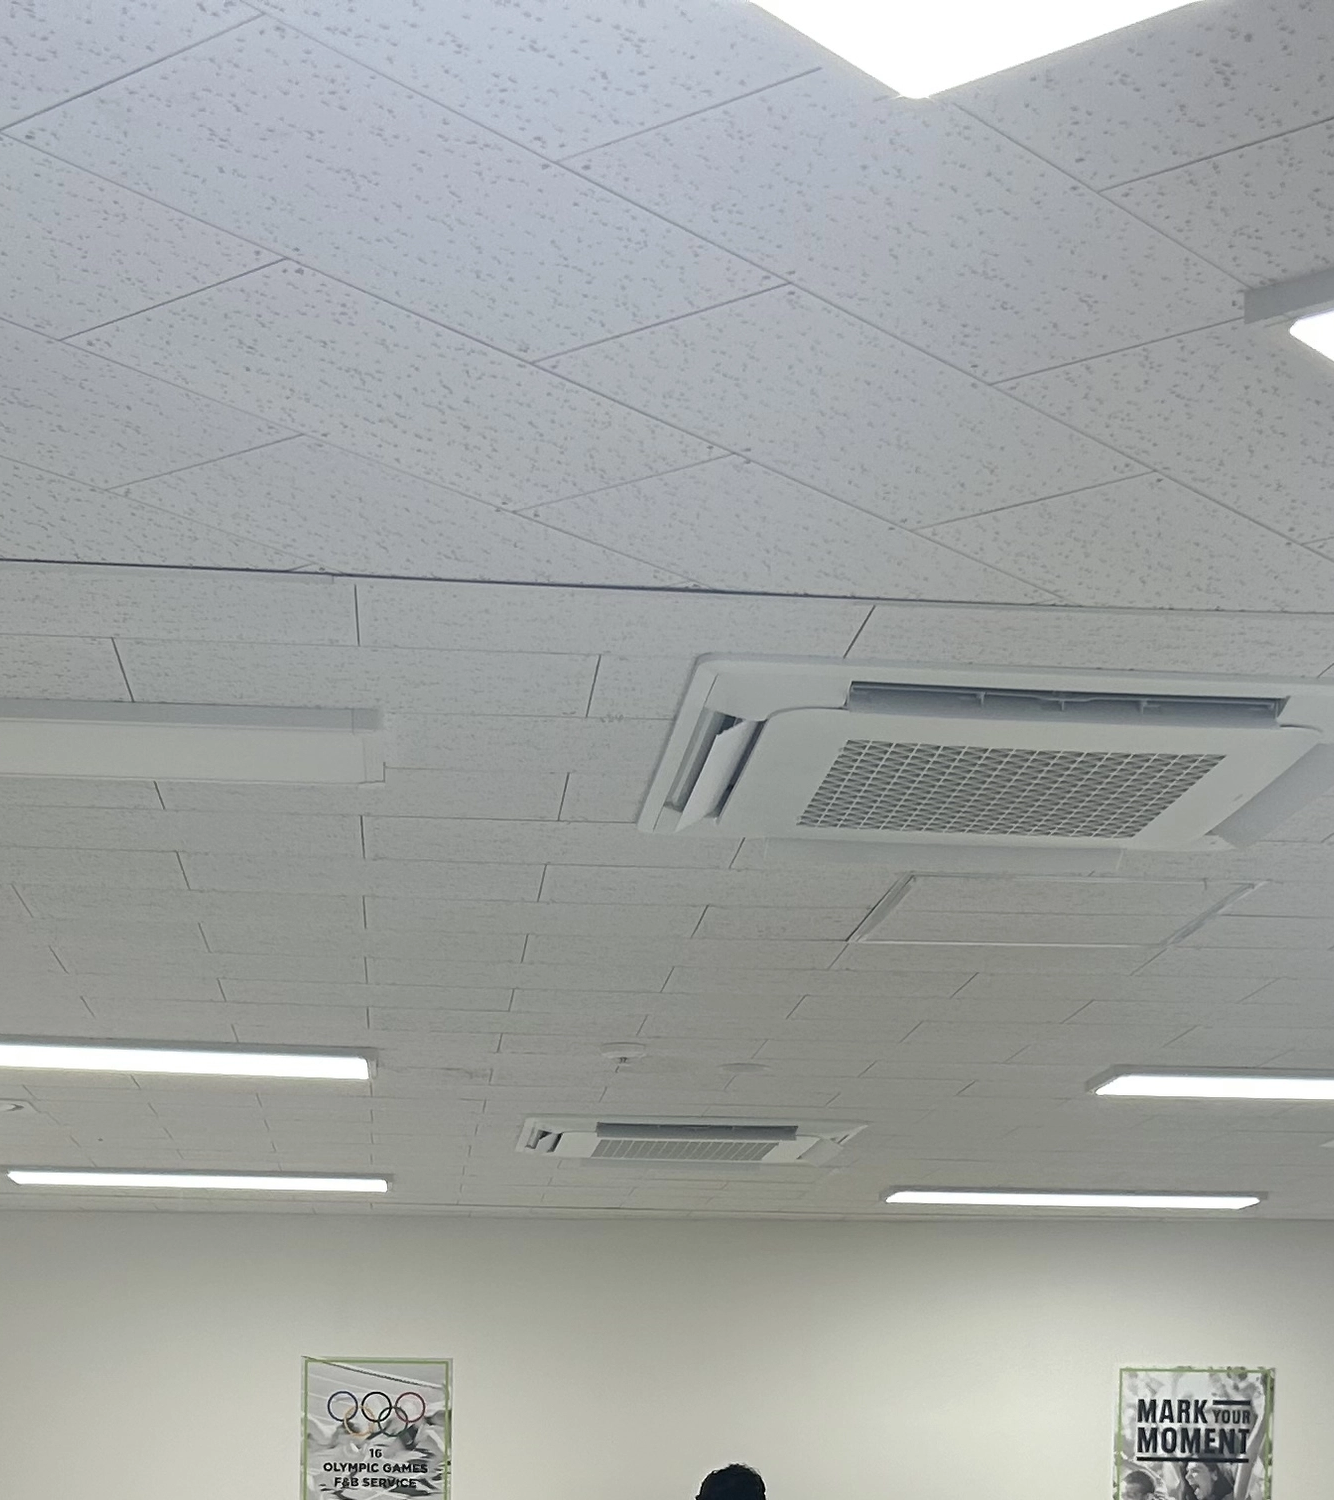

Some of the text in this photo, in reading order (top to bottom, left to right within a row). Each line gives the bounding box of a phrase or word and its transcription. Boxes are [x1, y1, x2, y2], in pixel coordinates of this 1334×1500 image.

[1137, 1398, 1251, 1424] MARK YOUR
[1137, 1427, 1251, 1455] MOMENT
[369, 1448, 382, 1458] 16
[323, 1462, 428, 1474] OLYMPIC GAMES
[334, 1477, 417, 1488] F&B SERVICE
